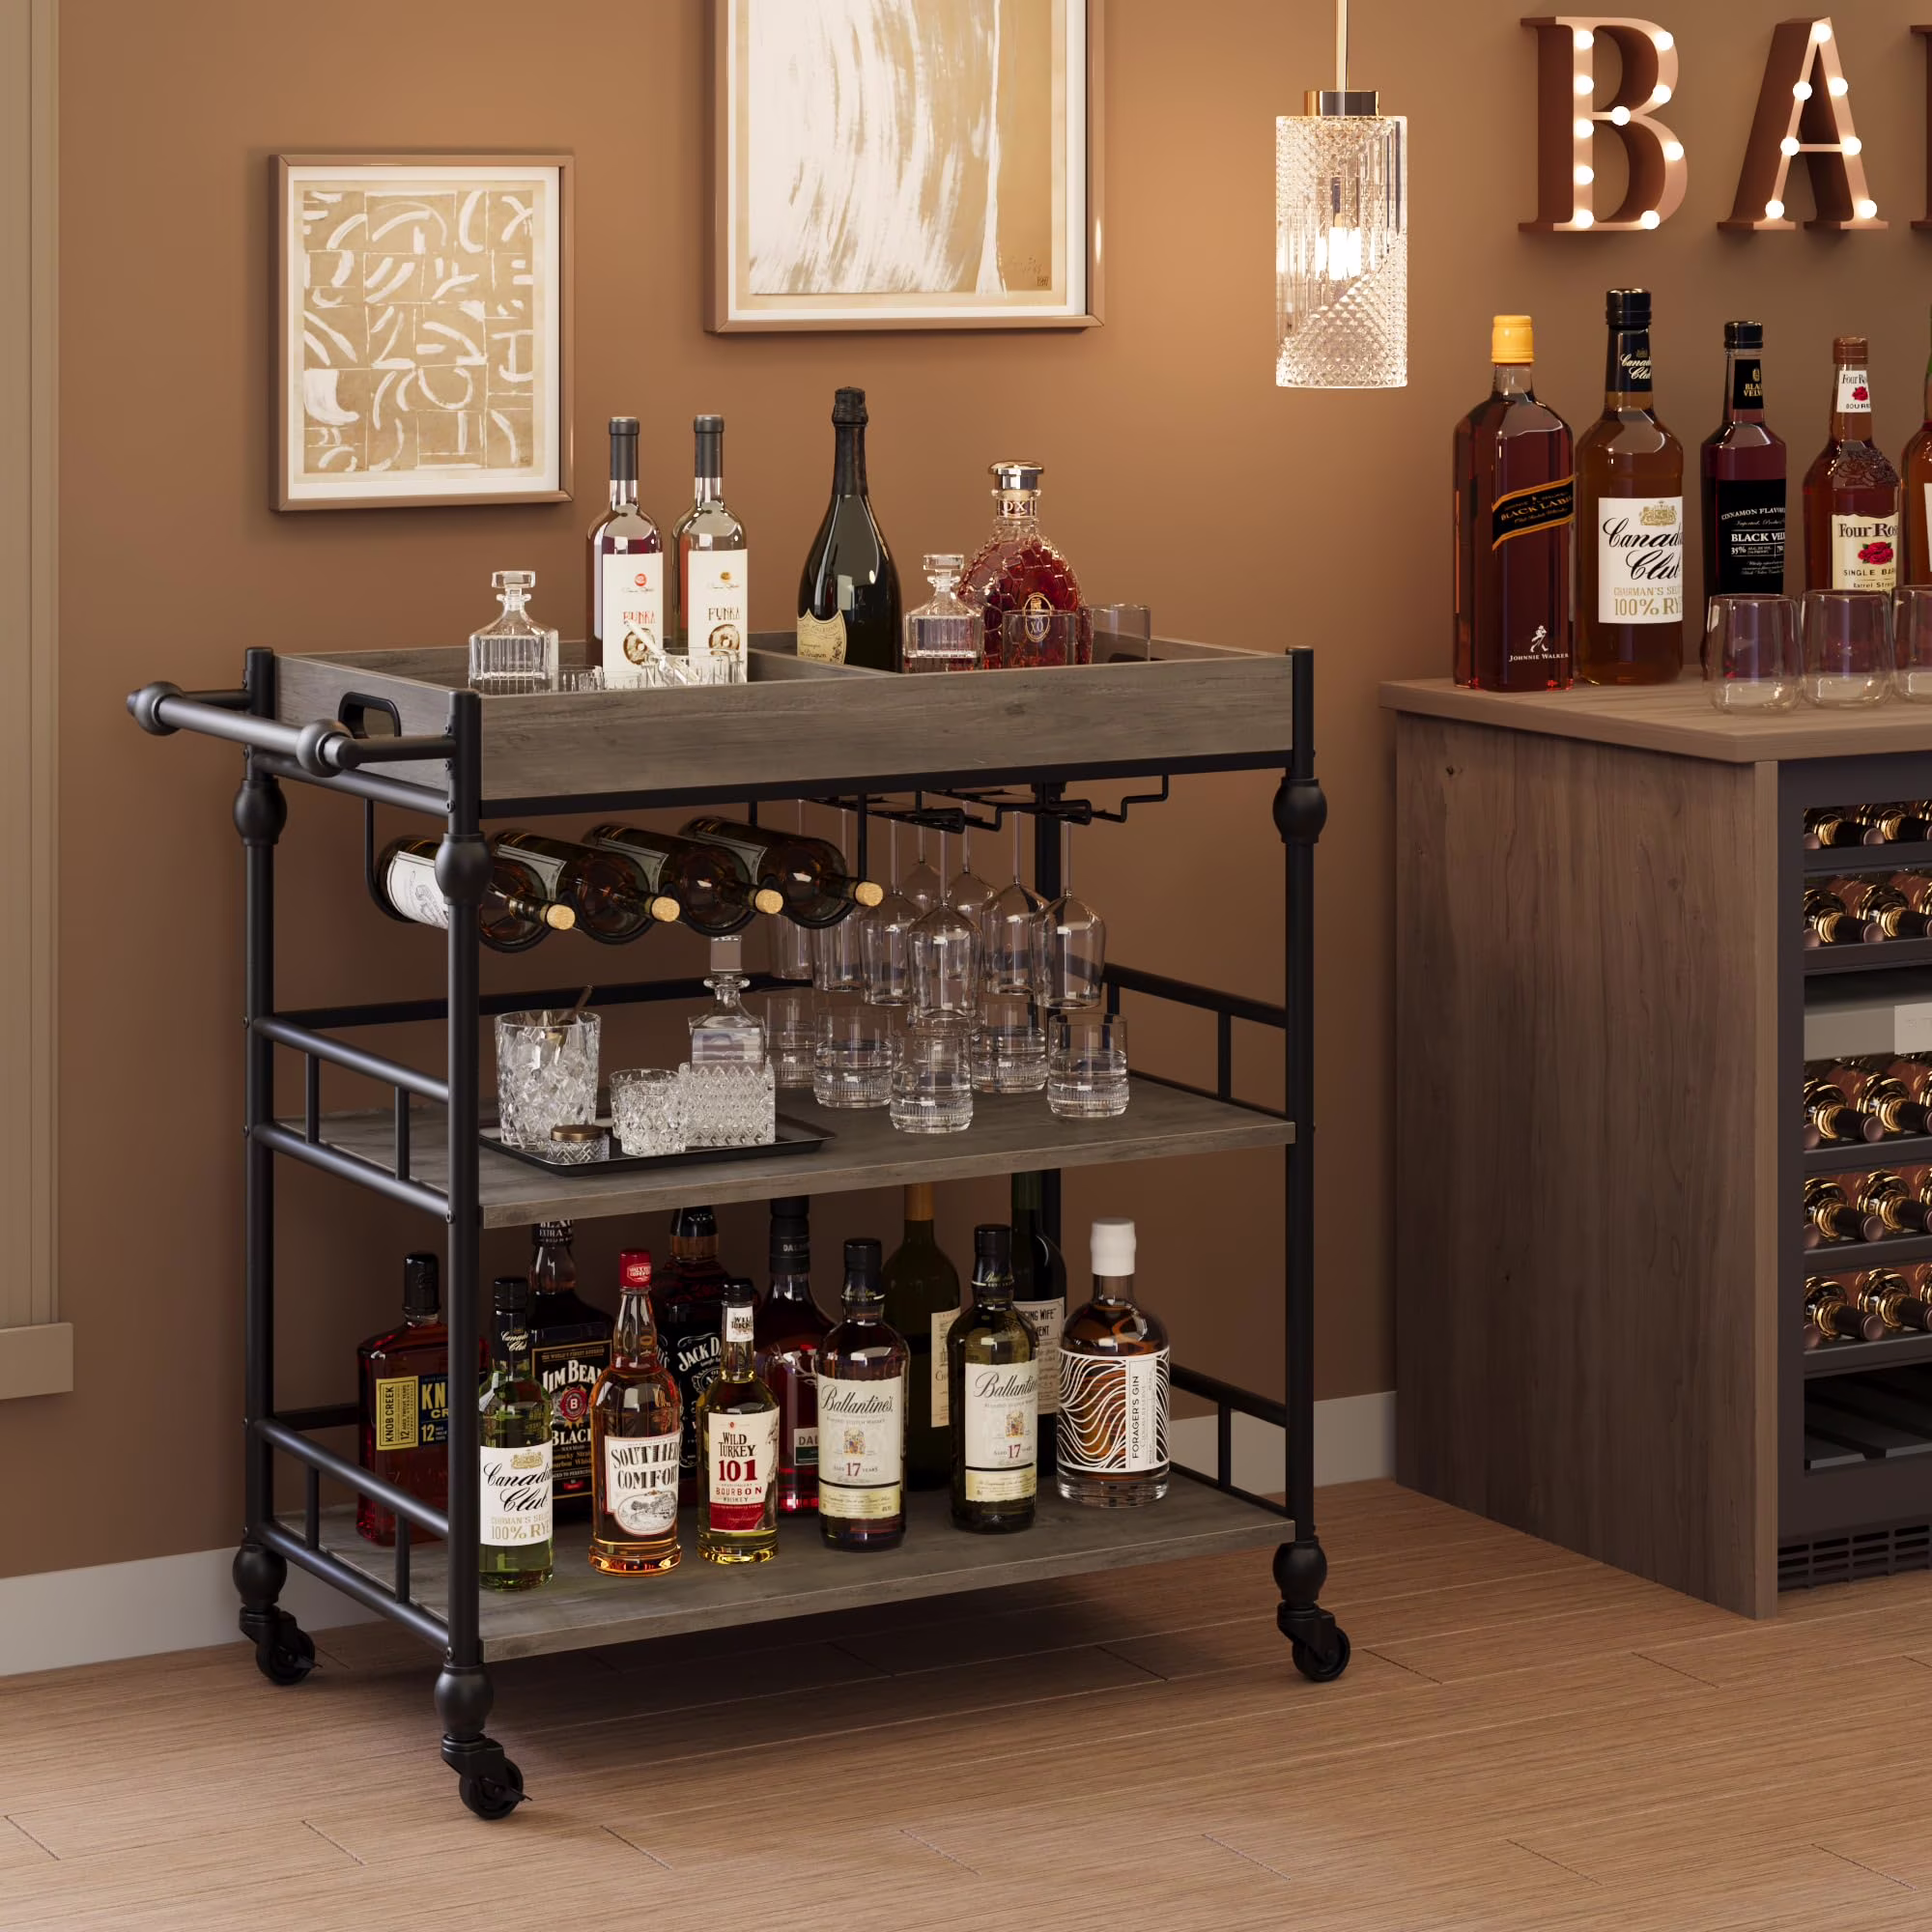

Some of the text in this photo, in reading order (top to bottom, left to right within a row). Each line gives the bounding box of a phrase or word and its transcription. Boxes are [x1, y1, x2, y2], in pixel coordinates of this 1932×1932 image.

[1519, 15, 1932, 232] BA
[1841, 374, 1858, 384] Four
[1500, 506, 1538, 521] BLACK
[1720, 508, 1758, 521] CINNAMON
[1730, 532, 1770, 542] BLACK
[1838, 523, 1872, 538] Four
[1614, 598, 1660, 616] 100%
[1508, 652, 1569, 663] JOHNNIE WALKER
[677, 1344, 709, 1372] JACK
[542, 1359, 602, 1394] JIM BEA
[421, 1381, 446, 1410] KN
[820, 1384, 894, 1413] Ballantine's
[570, 1398, 578, 1409] B
[384, 1386, 394, 1442] KNOB CREEK
[431, 1407, 448, 1419] CR
[1131, 1376, 1140, 1459] FORAGER'S GIN
[400, 1431, 410, 1440] 12
[421, 1424, 435, 1441] 12
[723, 1432, 748, 1445] WILD
[798, 1435, 818, 1446] DAL
[718, 1441, 756, 1458] TURKEY
[1009, 1443, 1021, 1459] 17
[718, 1459, 758, 1482] 101
[846, 1463, 862, 1477] 17
[716, 1487, 762, 1496] BOURBON
[491, 1525, 527, 1540] 100%
